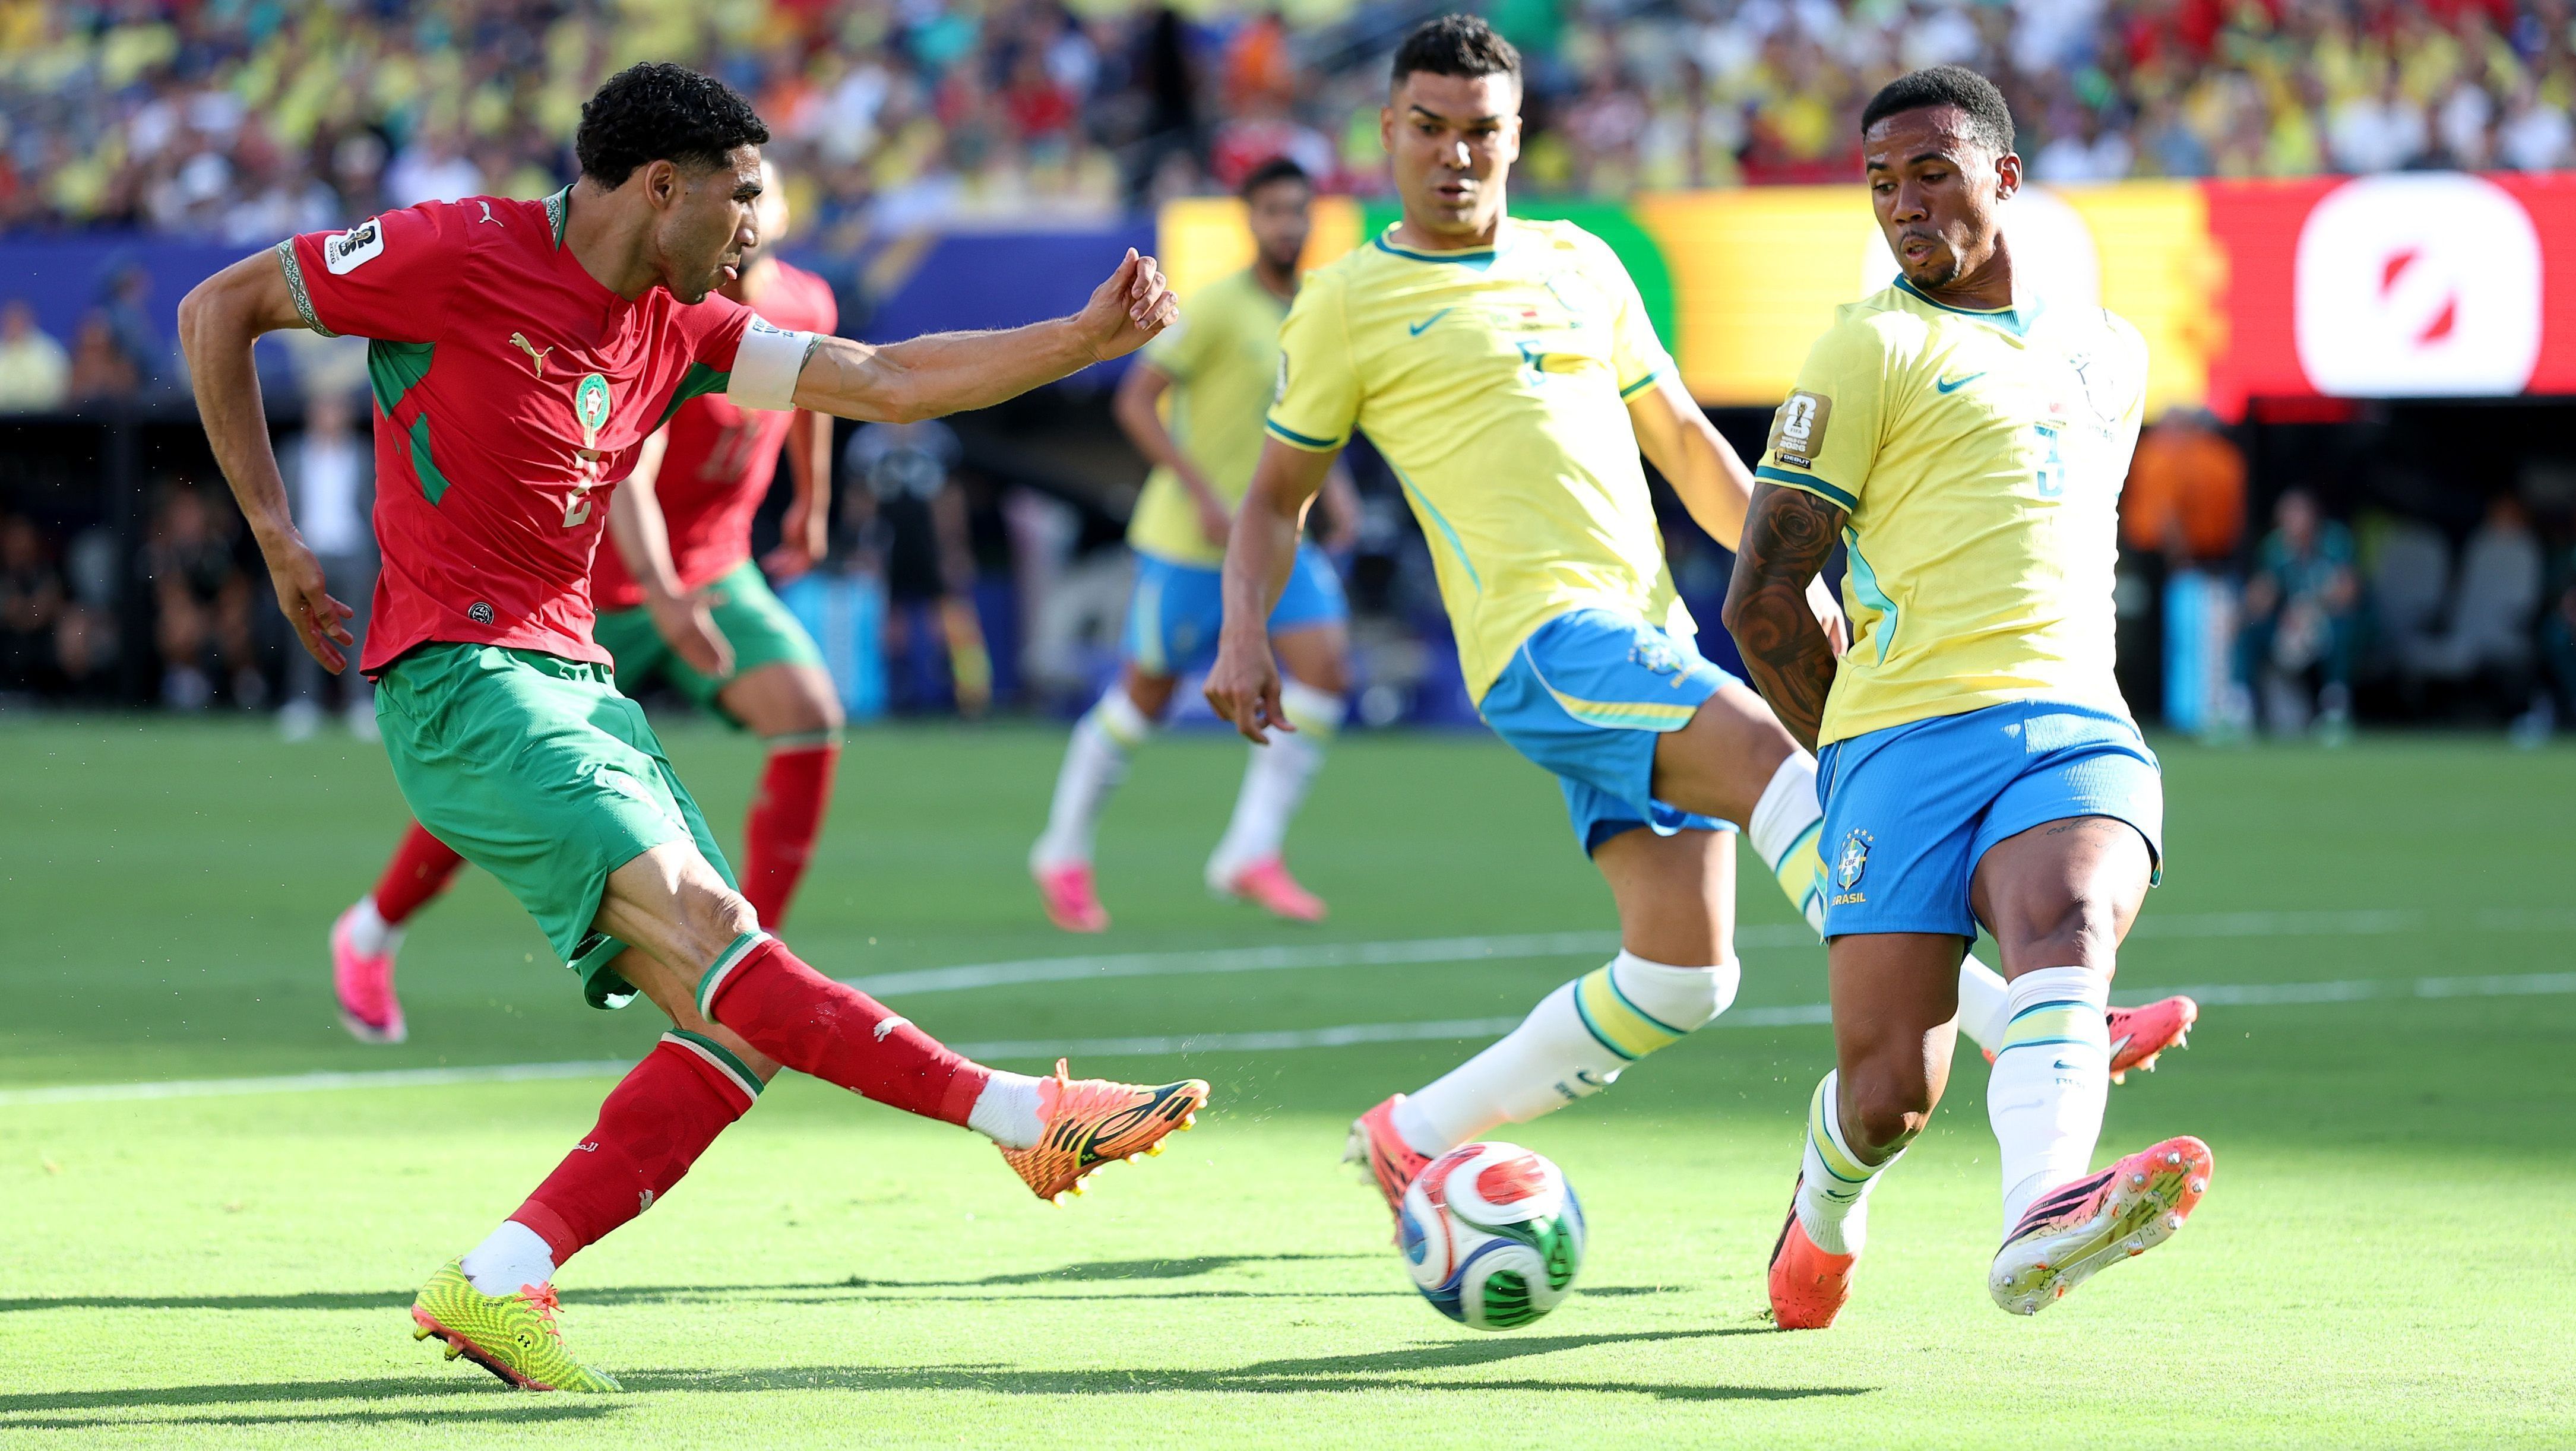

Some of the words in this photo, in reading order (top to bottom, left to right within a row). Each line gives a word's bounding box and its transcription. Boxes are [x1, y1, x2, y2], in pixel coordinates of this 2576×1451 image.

[1780, 440, 1806, 452] 2026
[1784, 454, 1810, 465] DEBUT
[562, 449, 602, 528] 2
[1844, 858, 1856, 867] CBF
[1831, 892, 1866, 906] BRASIL
